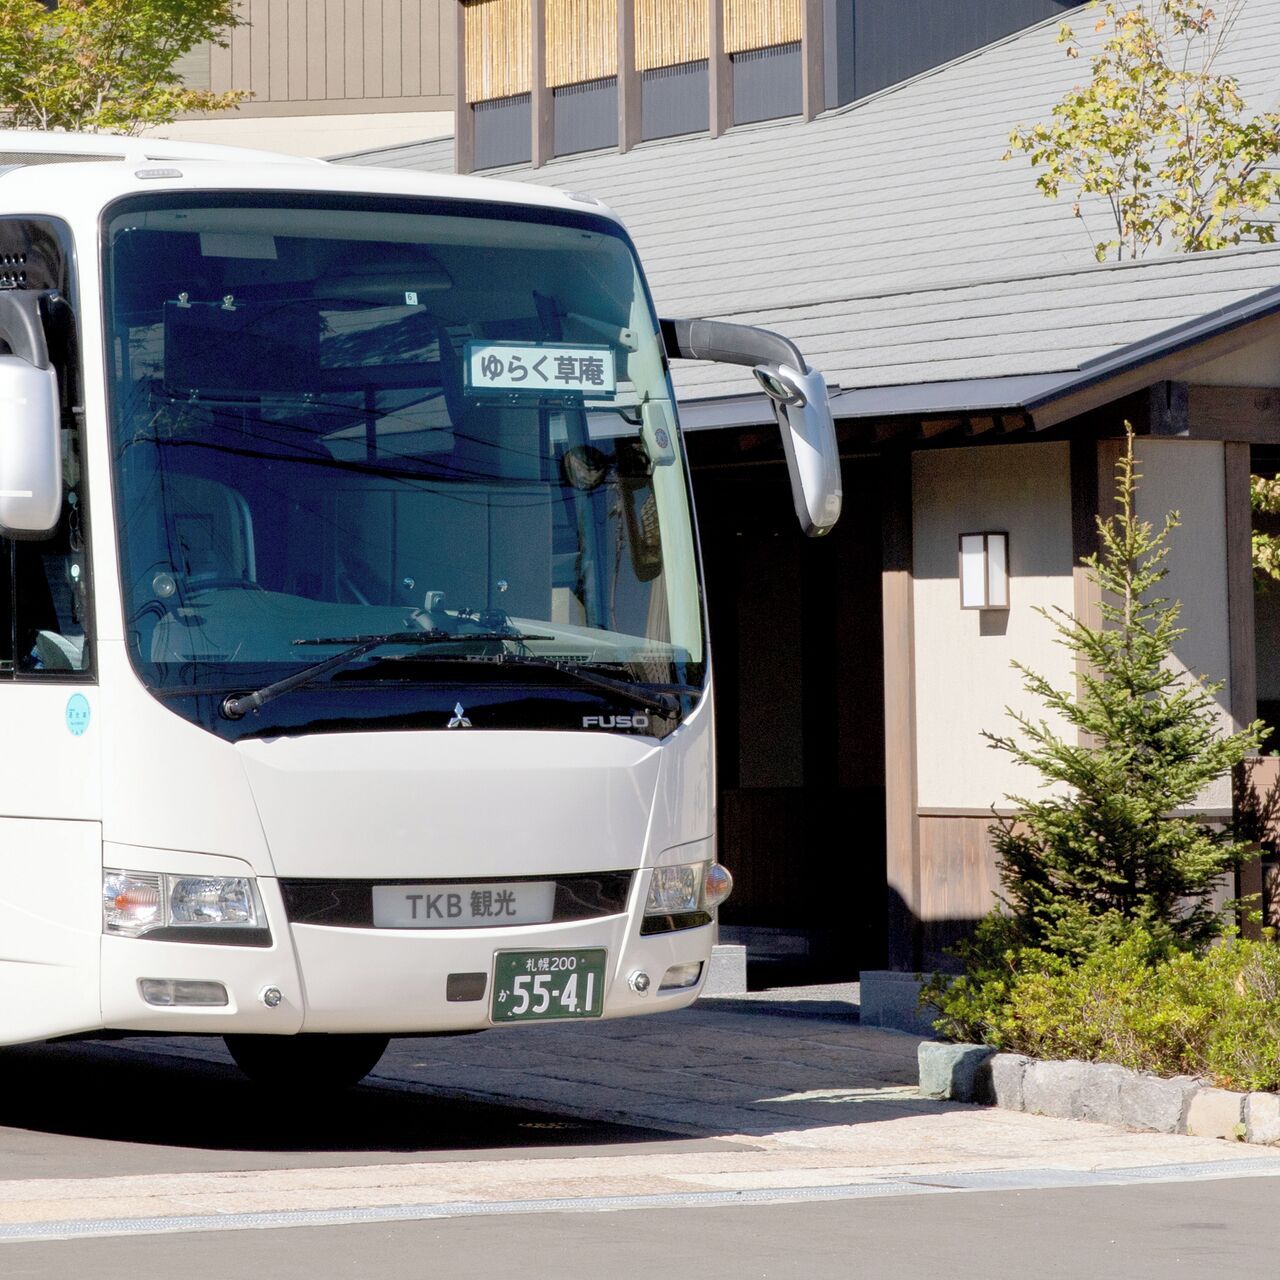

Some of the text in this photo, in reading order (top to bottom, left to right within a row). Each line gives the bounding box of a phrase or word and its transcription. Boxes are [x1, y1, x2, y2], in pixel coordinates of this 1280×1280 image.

[481, 353, 605, 386] ゆらく草庵
[582, 715, 649, 728] FUSO
[405, 889, 517, 919] TKB 観光
[512, 972, 595, 1014] 55-41
